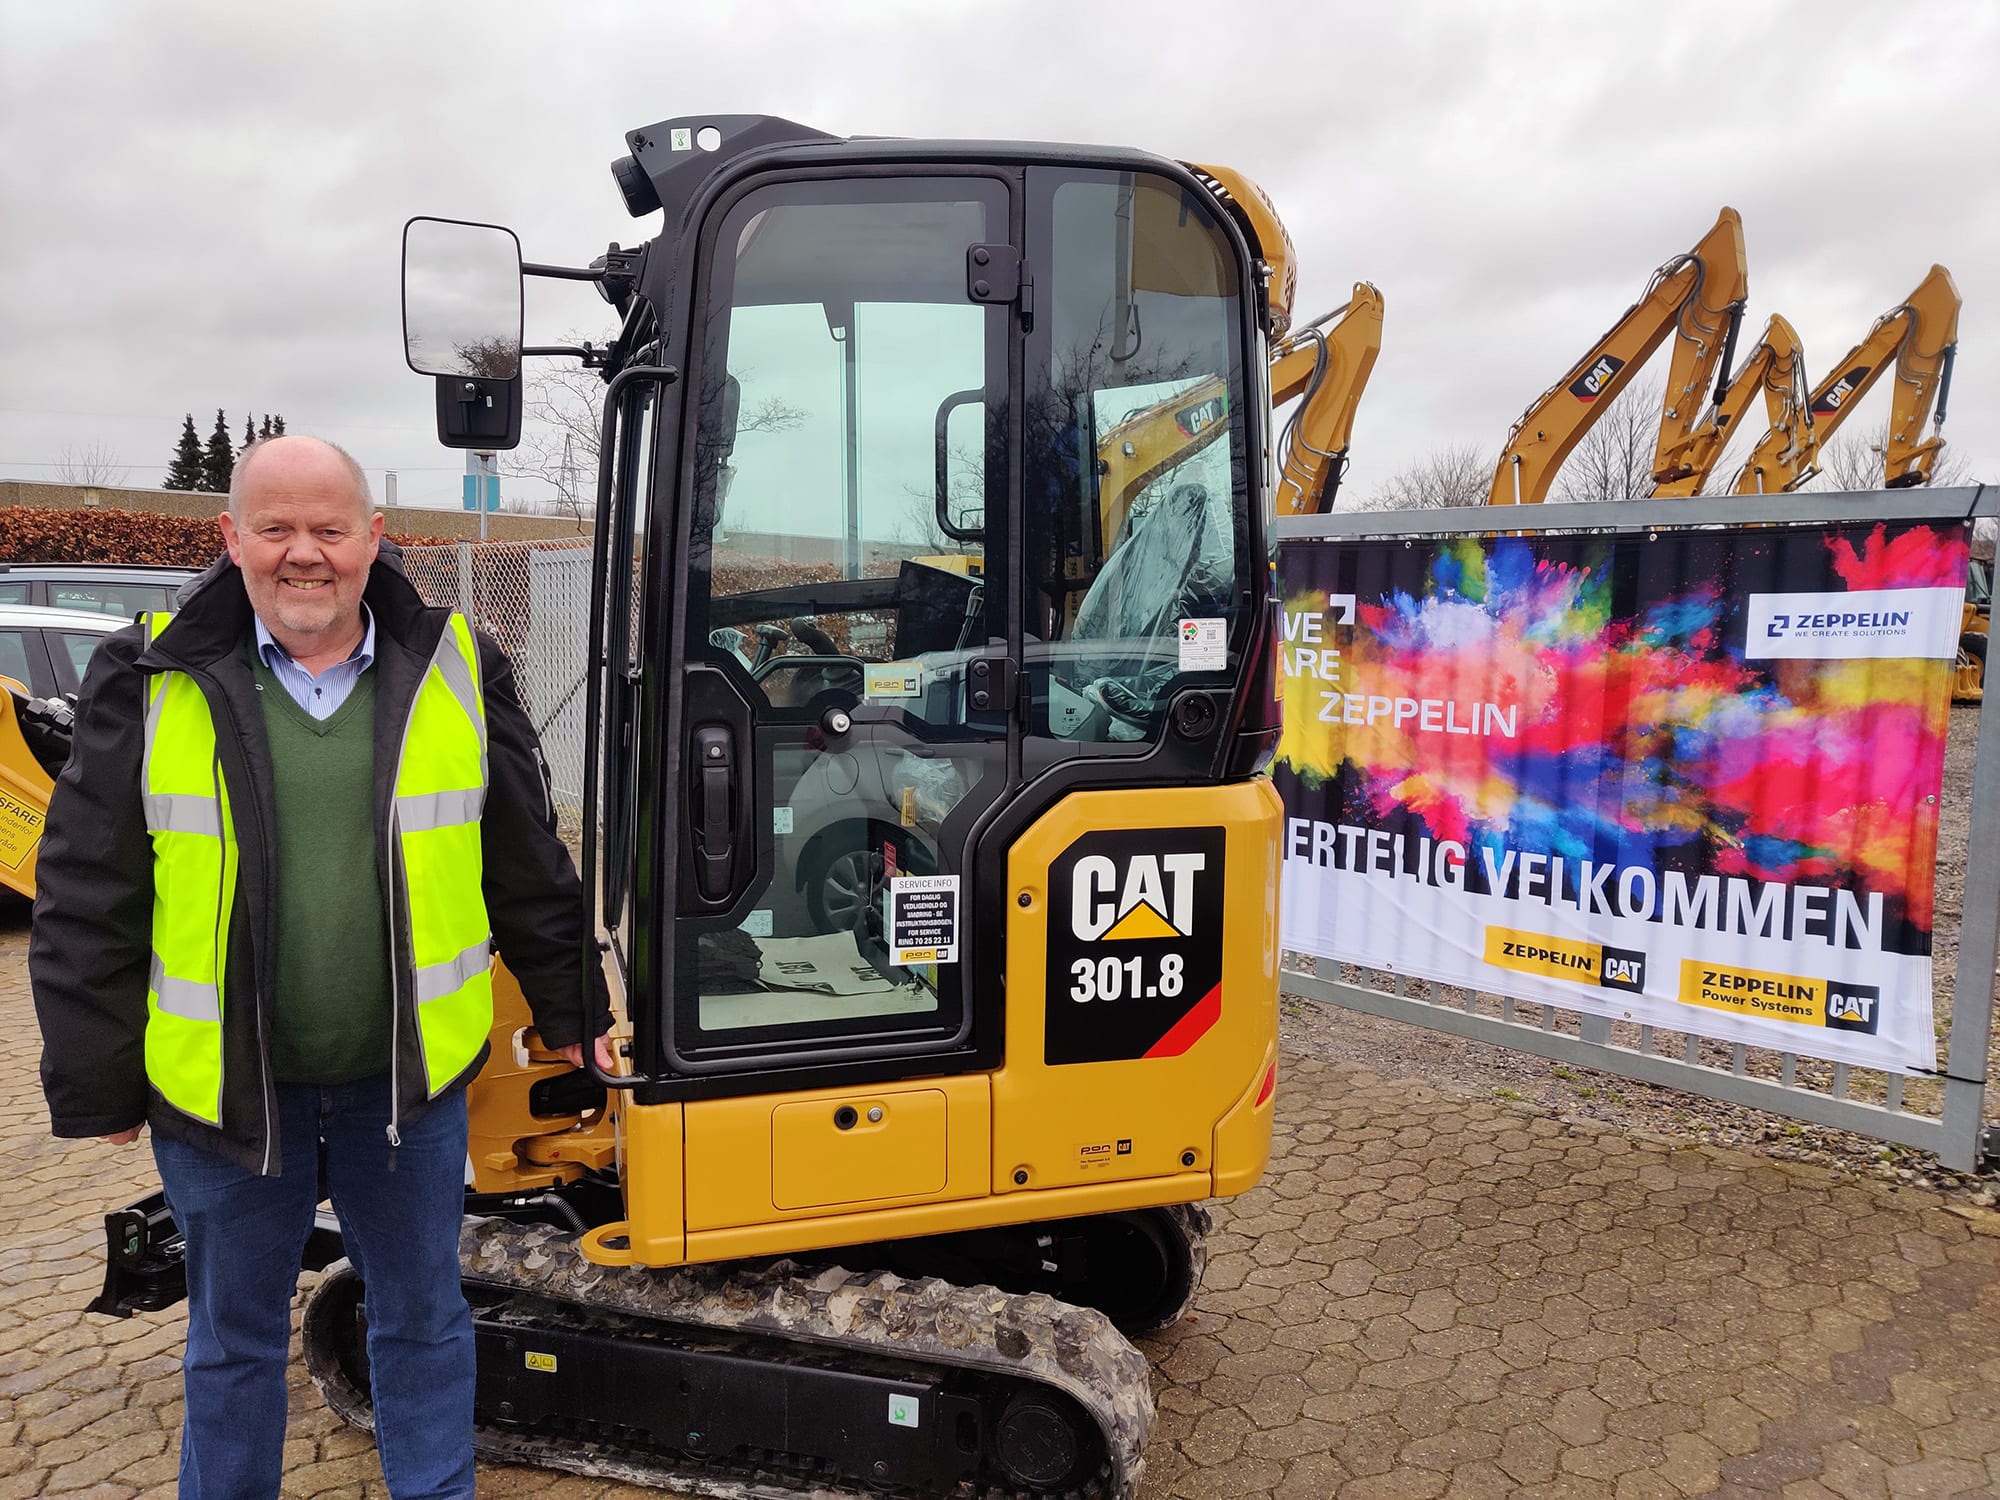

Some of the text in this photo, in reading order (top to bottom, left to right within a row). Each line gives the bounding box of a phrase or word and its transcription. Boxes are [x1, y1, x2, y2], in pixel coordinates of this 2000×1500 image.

[1583, 358, 1614, 393] CAT
[1826, 377, 1854, 408] CAT
[1190, 401, 1214, 433] CAT
[1797, 611, 1910, 629] ZEPPELIN
[1852, 629, 1907, 638] SOLUTIONS
[1318, 691, 1517, 738] ZEPPELIN
[899, 879, 953, 889] SERVICE INFO
[1072, 853, 1205, 941] CAT
[1482, 846, 1884, 952] VELKOMMEN
[898, 936, 951, 946] RING 70 25 22 11
[1070, 953, 1184, 1003] 301.8
[1502, 942, 1641, 984] ZEPPELIN CAT
[1701, 971, 1874, 1023] ZEPPELIN CAT
[1701, 988, 1813, 1016] Power Systems
